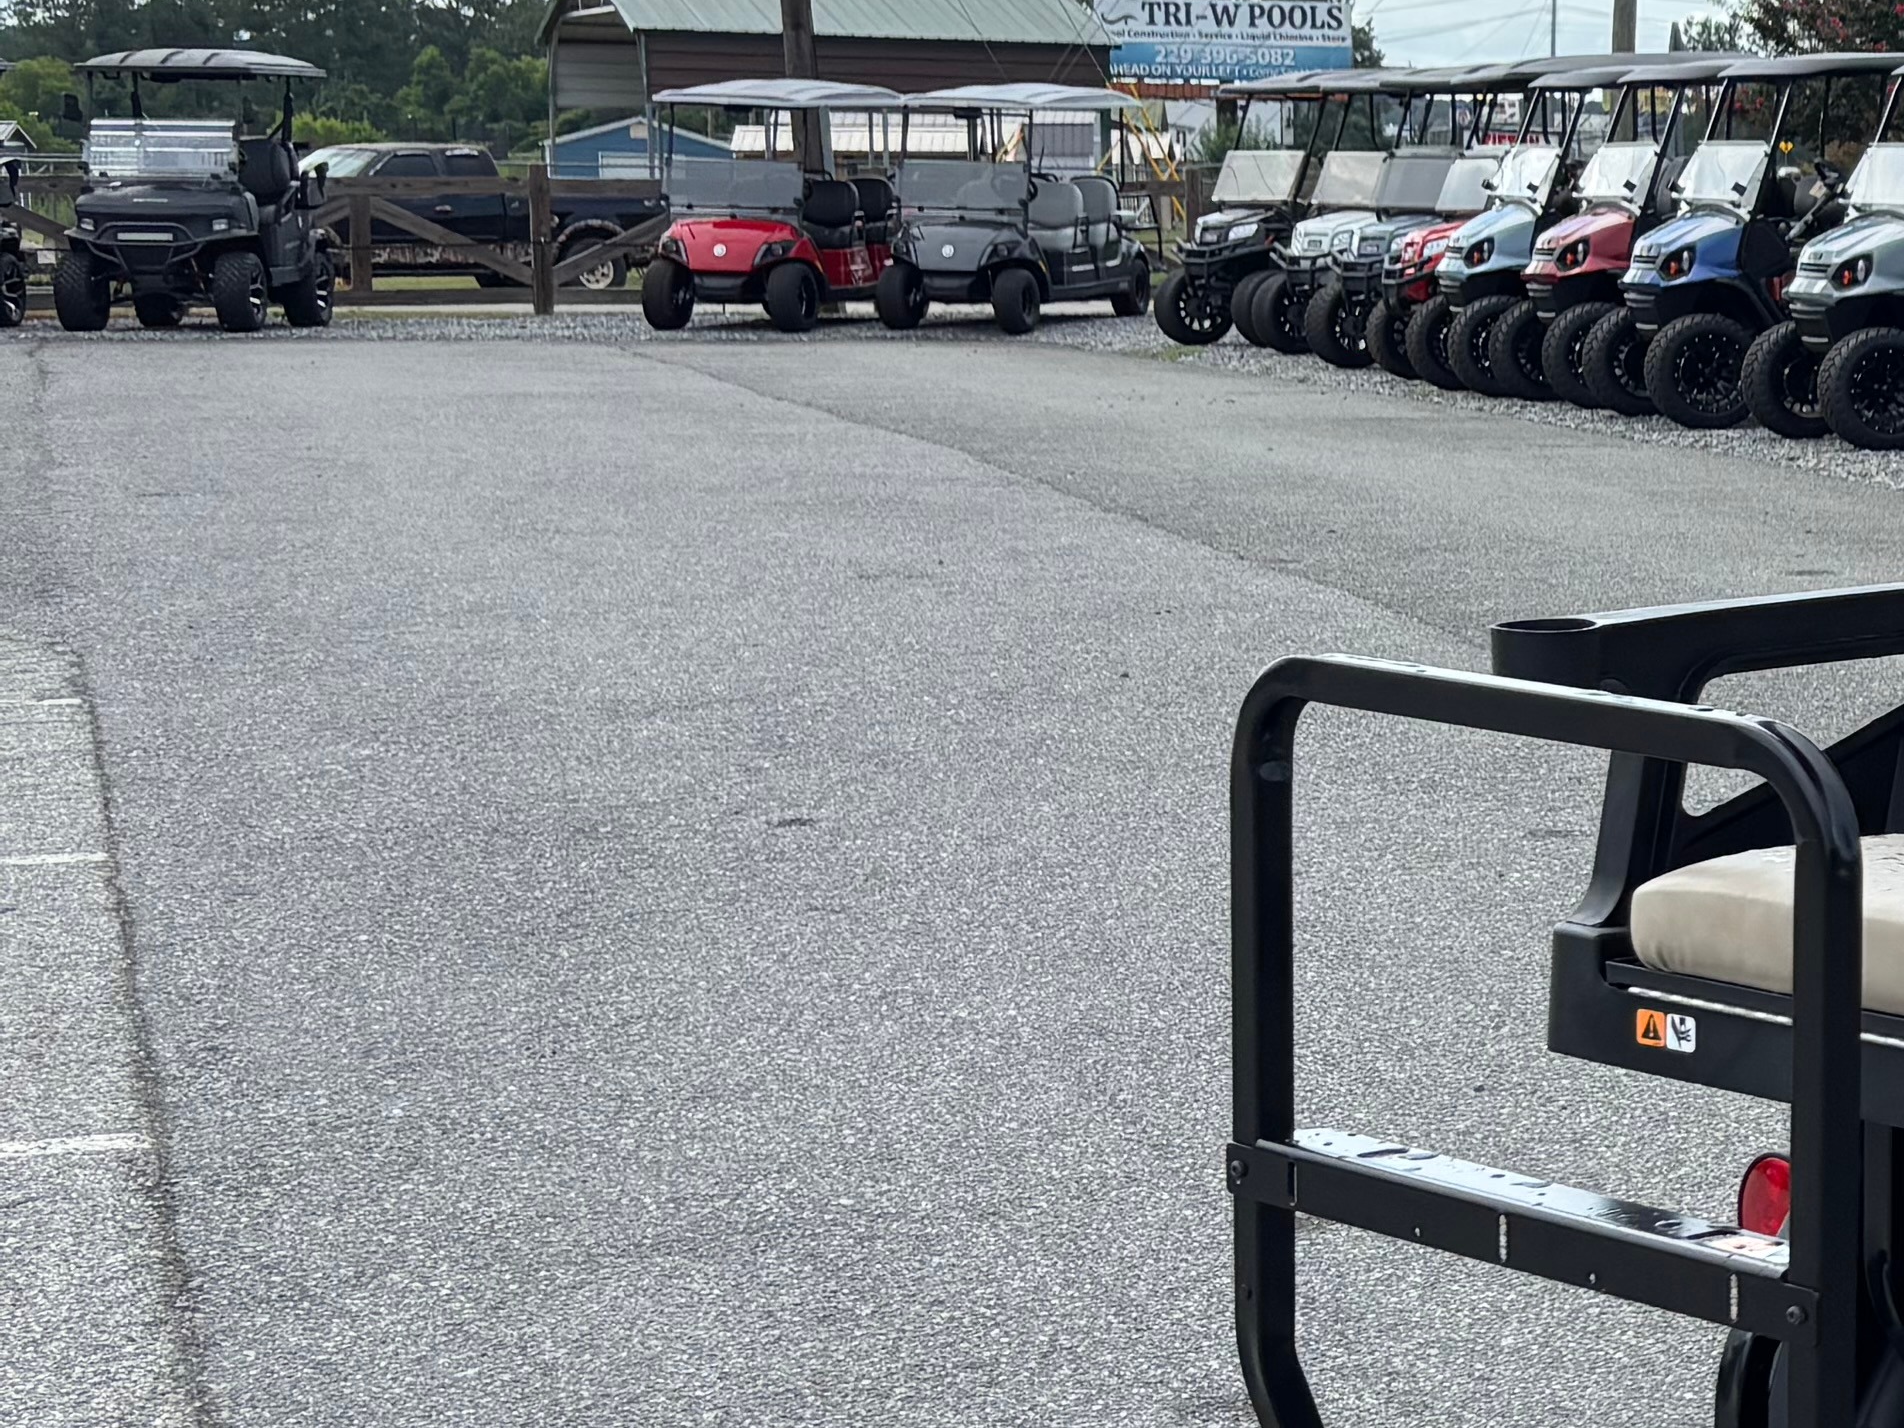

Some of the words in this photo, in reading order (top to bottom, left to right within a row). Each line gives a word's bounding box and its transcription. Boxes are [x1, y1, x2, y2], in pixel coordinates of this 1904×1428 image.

[1141, 1, 1242, 29] TRI-W
[1248, 3, 1343, 31] POOLS
[1151, 63, 1172, 76] ON
